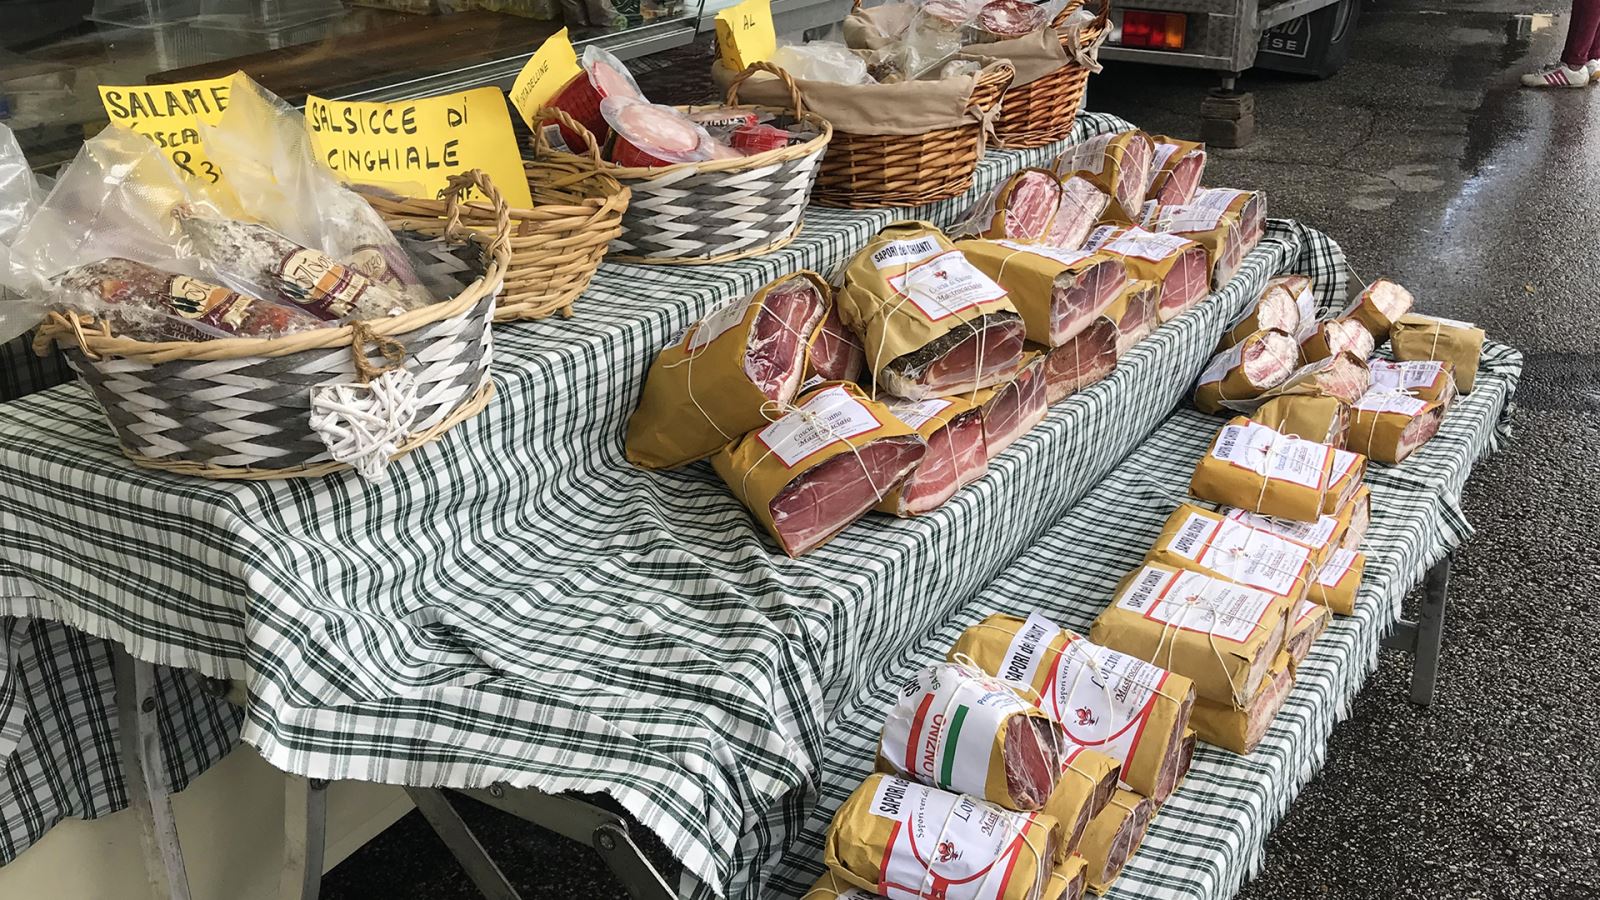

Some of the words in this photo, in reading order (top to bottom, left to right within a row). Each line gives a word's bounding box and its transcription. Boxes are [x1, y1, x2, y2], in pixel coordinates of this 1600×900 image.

[105, 86, 231, 118] SALAME
[312, 102, 418, 135] SALSICCE
[327, 139, 460, 172] CINGHIALE
[874, 246, 897, 263] SAPORI
[908, 240, 933, 256] CHIANTI
[1005, 651, 1031, 682] SAPORI
[879, 784, 906, 815] SAPORI
